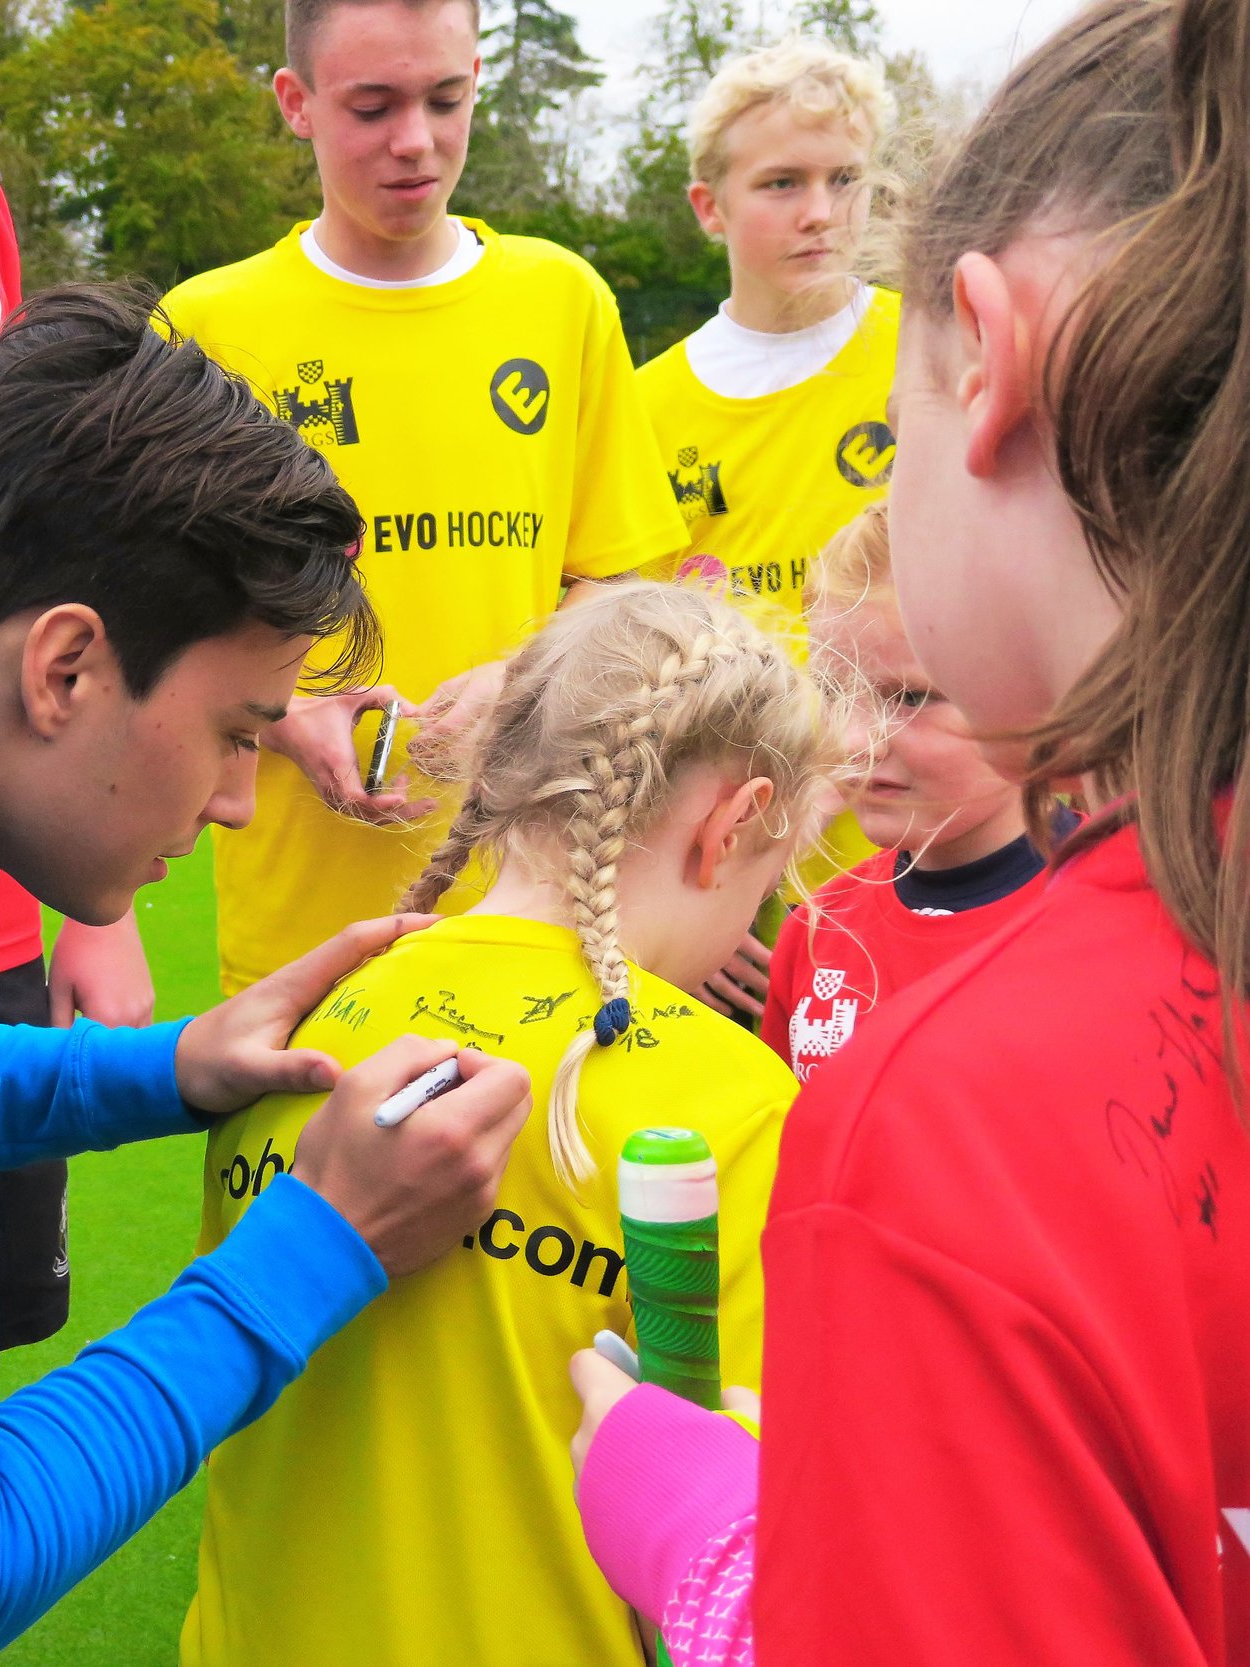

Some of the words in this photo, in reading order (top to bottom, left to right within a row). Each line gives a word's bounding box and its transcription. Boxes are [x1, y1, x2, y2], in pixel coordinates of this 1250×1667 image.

[374, 512, 437, 553] EVO
[448, 510, 544, 550] HOCKEY
[730, 562, 782, 597] EVO
